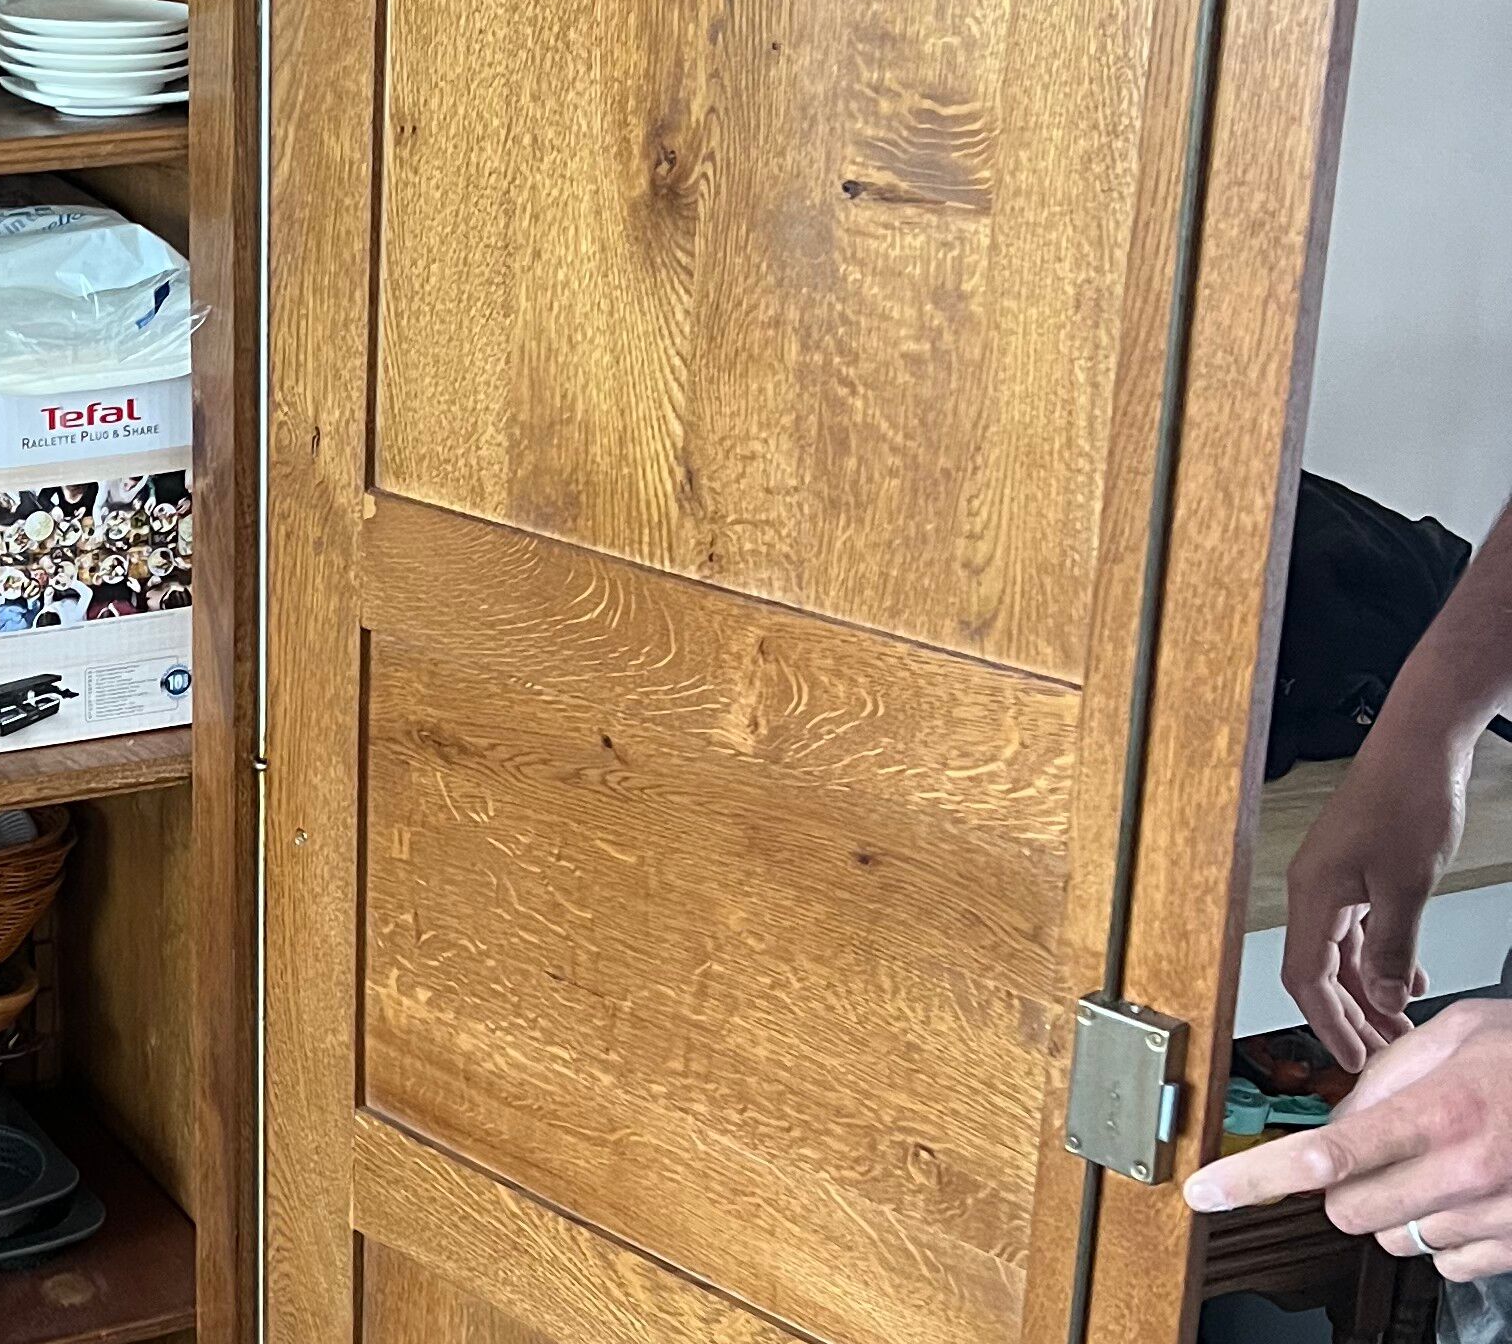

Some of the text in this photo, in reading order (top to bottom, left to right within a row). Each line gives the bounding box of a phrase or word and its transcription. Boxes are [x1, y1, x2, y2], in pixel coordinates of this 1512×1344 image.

[41, 398, 142, 431] Tefal
[22, 424, 160, 449] RACLETTE PLUG & SHARE
